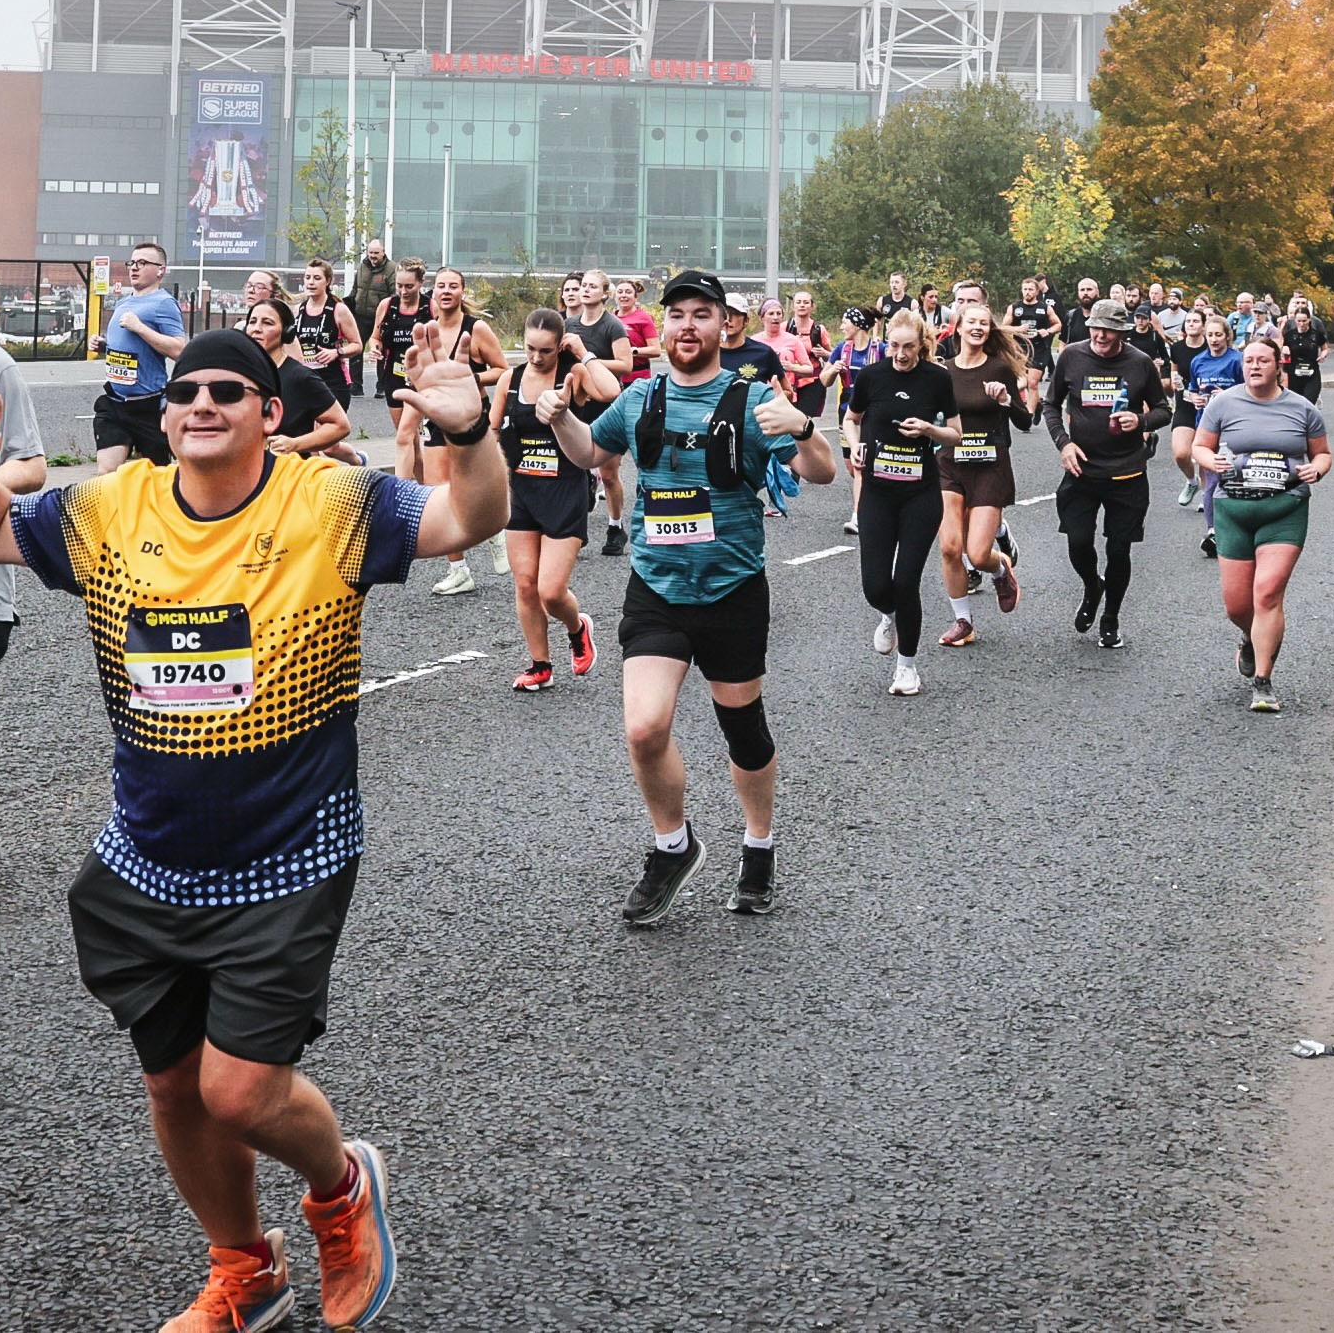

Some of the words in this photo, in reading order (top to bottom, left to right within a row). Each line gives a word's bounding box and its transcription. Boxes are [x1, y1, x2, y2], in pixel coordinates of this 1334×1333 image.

[432, 53, 629, 77] MANCHESTER
[650, 59, 754, 81] UNITED
[202, 82, 260, 93] BETFRED
[223, 100, 260, 110] SUPER
[223, 110, 259, 118] LEAGUE
[109, 357, 132, 366] ASHLEY
[536, 448, 557, 457] MAE
[521, 460, 547, 469] 21475
[883, 465, 913, 475] 21242
[1251, 470, 1282, 479] 27408
[657, 491, 673, 499] MCR
[673, 490, 697, 498] HALF
[656, 521, 698, 534] 30813
[140, 541, 164, 557] DC
[158, 612, 188, 625] MCR
[190, 610, 229, 624] HALF
[171, 632, 202, 650] DC
[151, 663, 226, 684] 19740
